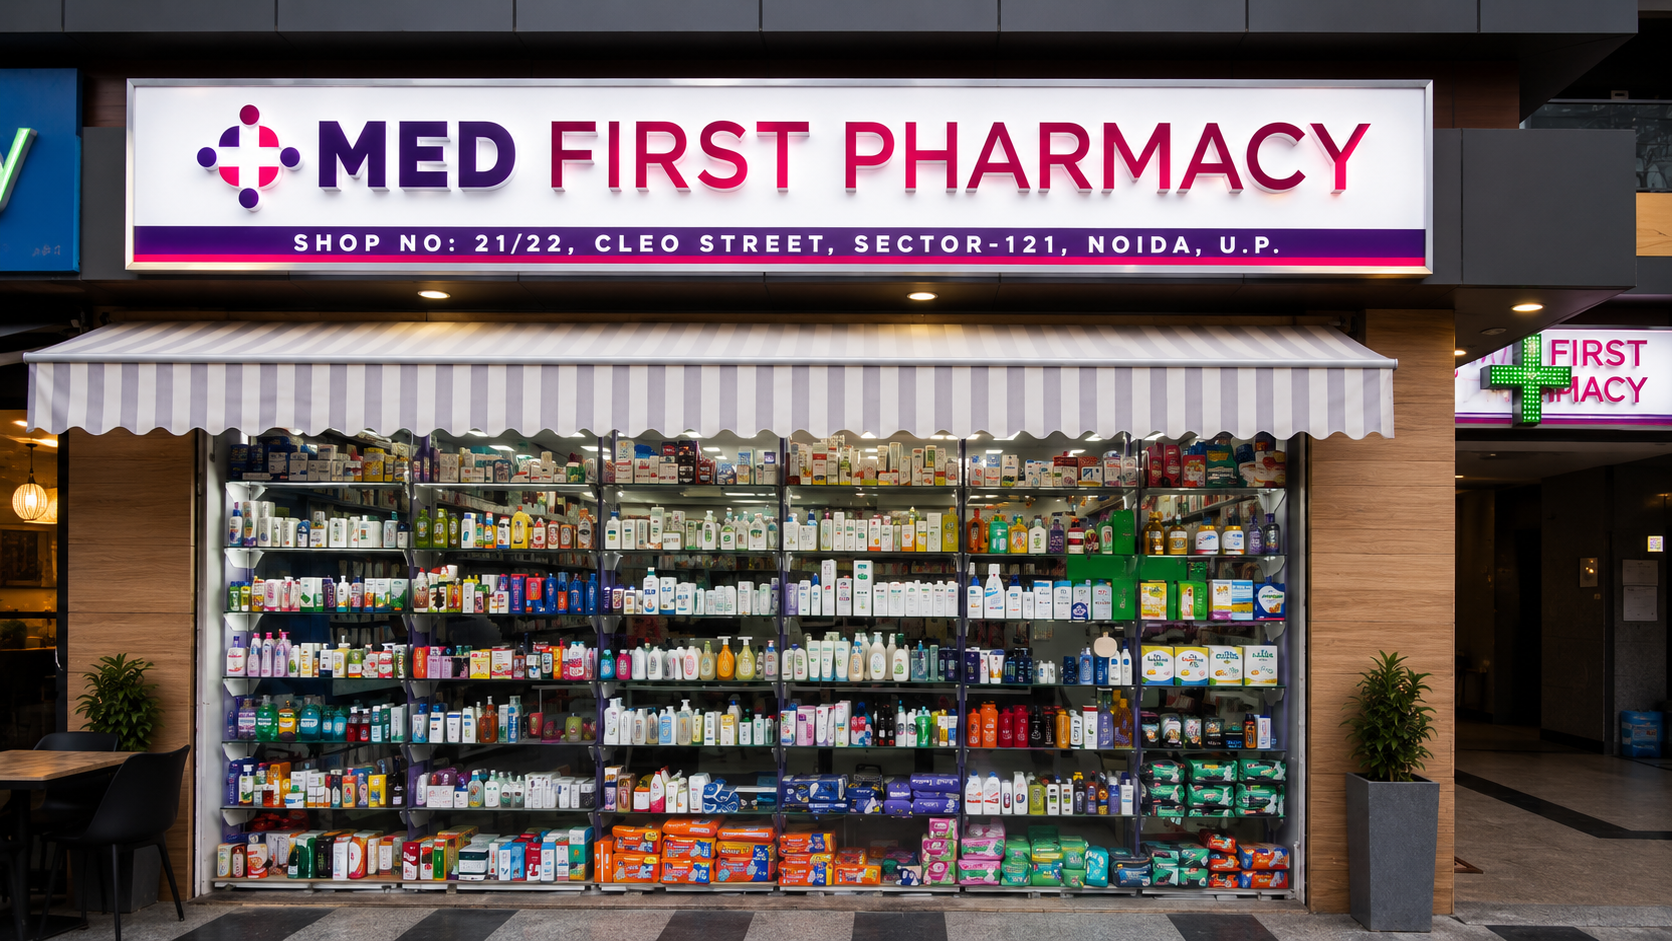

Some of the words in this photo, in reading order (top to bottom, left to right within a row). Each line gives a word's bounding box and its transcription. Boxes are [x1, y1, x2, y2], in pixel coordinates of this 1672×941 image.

[318, 120, 516, 189] MED
[551, 120, 810, 190] FIRST
[845, 121, 1371, 191] PHARMACY
[294, 233, 380, 252] SHOP
[400, 234, 455, 252] NO:
[474, 233, 574, 256] 21/22,
[594, 234, 679, 253] CLEO
[699, 234, 834, 256] STREET,
[854, 234, 1067, 257] SECTOR-121,
[1088, 235, 1201, 257] NOIDA,
[1220, 236, 1279, 254] U.P.
[1551, 339, 1648, 367] FIRST
[1549, 375, 1648, 403] MACY
